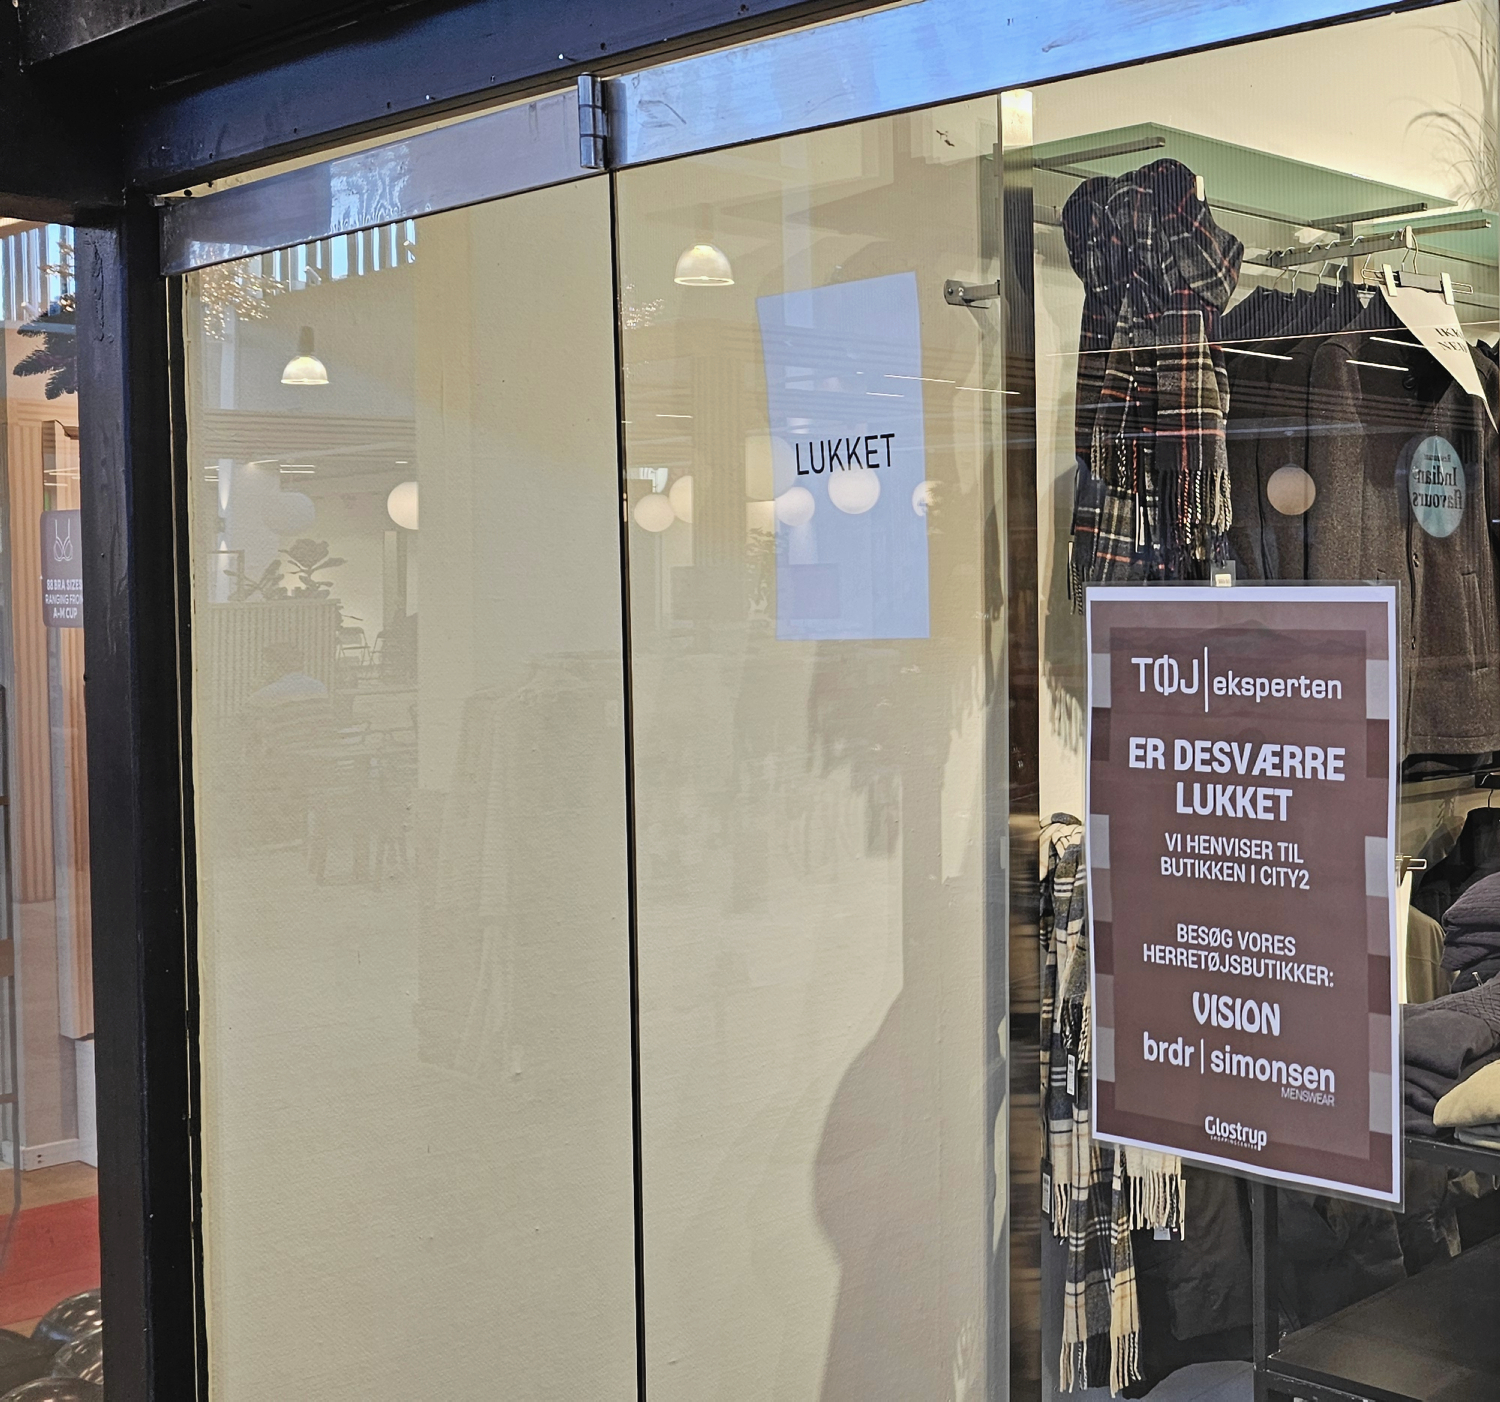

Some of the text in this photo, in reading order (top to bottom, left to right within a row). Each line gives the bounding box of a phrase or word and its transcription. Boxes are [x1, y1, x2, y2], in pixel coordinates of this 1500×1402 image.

[795, 433, 895, 476] LUKKET
[45, 593, 69, 605] RANGING
[65, 607, 78, 619] CUP
[1131, 654, 1343, 703] TØJ eksperten
[1128, 736, 1346, 782] ER DESVÆRRE
[1176, 781, 1293, 822] LUKKET
[1165, 832, 1304, 863] VI HENVISER TIL
[1160, 857, 1310, 890] BUTIKKEN I CITY2
[1177, 923, 1296, 956] BESØG VORES
[1143, 943, 1335, 987] HERRETØJSBUTIKKER:
[1192, 991, 1281, 1036] VISION
[1143, 1031, 1335, 1093] brdr simonsen
[1281, 1086, 1335, 1107] MENSWEAR
[1204, 1115, 1267, 1151] Glostrup
